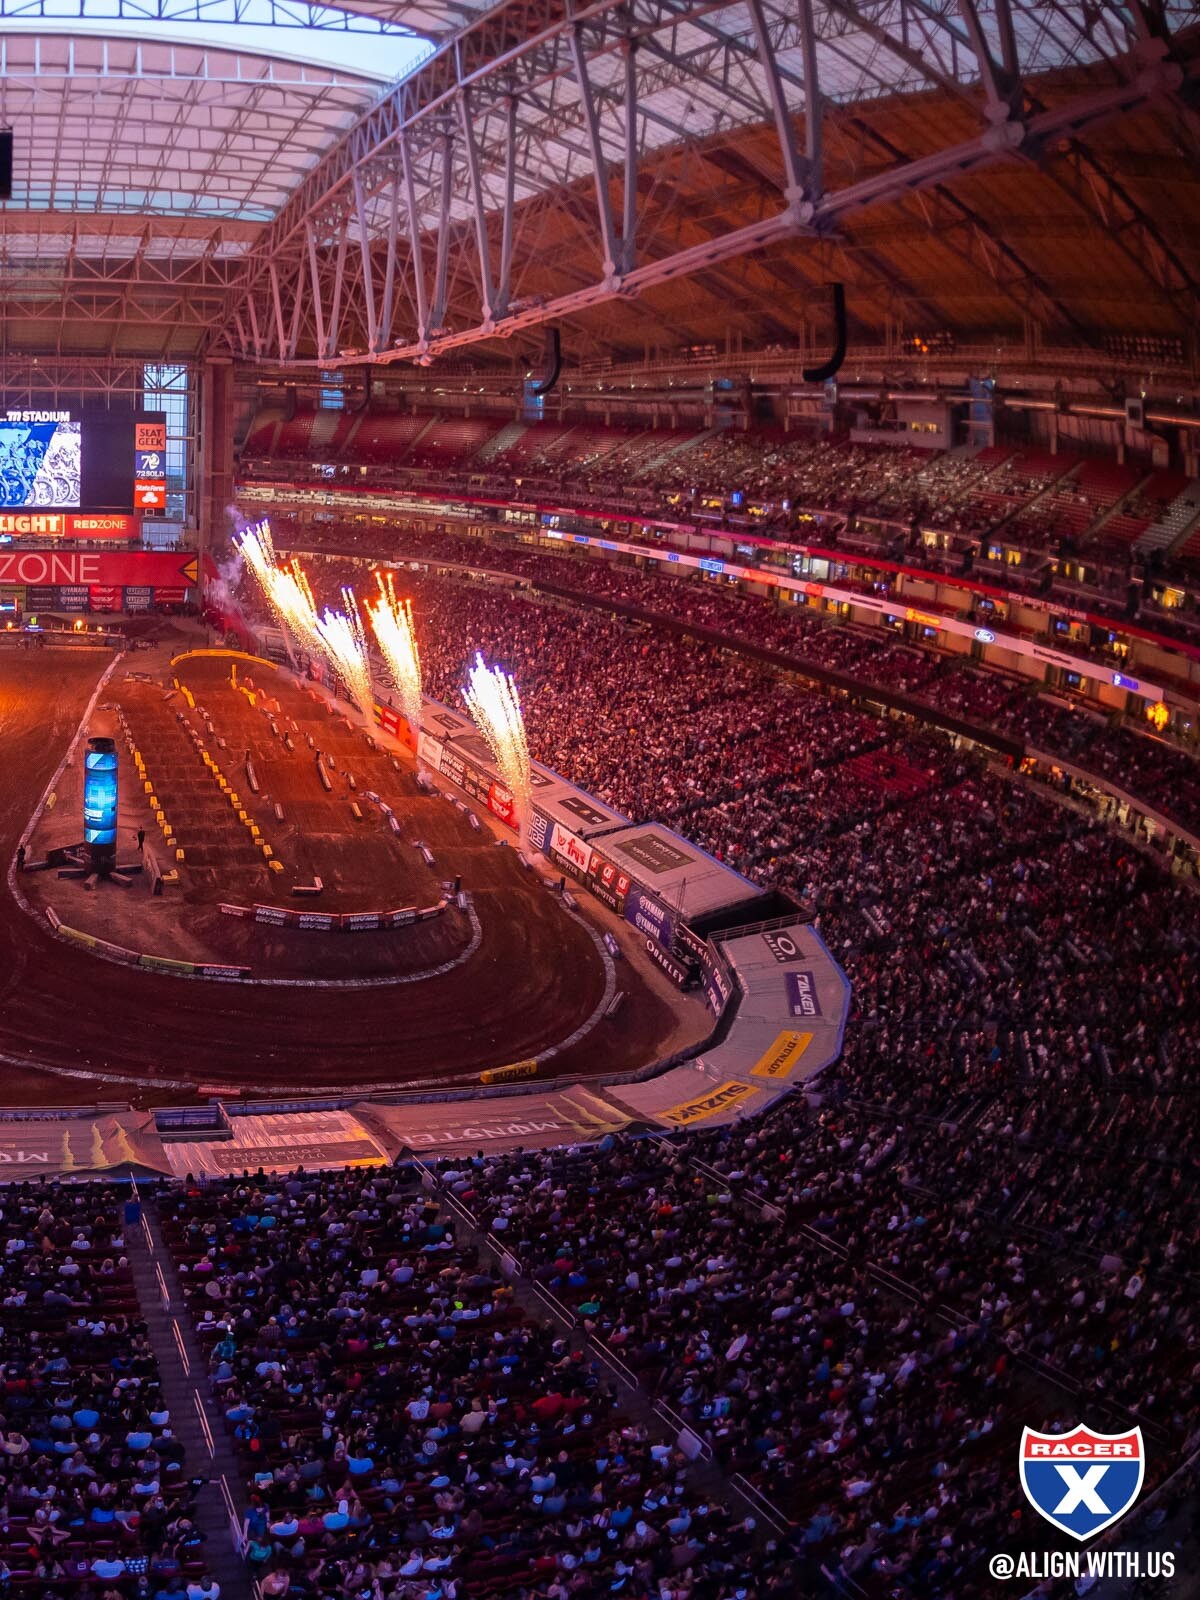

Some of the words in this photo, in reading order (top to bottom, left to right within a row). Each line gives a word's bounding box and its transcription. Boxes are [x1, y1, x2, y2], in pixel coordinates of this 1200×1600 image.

[23, 410, 70, 422] STADIUM
[139, 428, 163, 437] SEAT
[138, 438, 163, 447] GEEK
[0, 516, 61, 532] LIGHT
[73, 519, 127, 530] REDZONE
[763, 934, 786, 961] OAKLEY
[654, 950, 684, 983] OAKLEY
[796, 974, 816, 1015] FALKEN
[767, 1041, 797, 1074] DUNLOP
[666, 1084, 748, 1121] SUZUKI
[221, 1155, 279, 1164] SPORTS
[287, 1152, 326, 1162] UTAH
